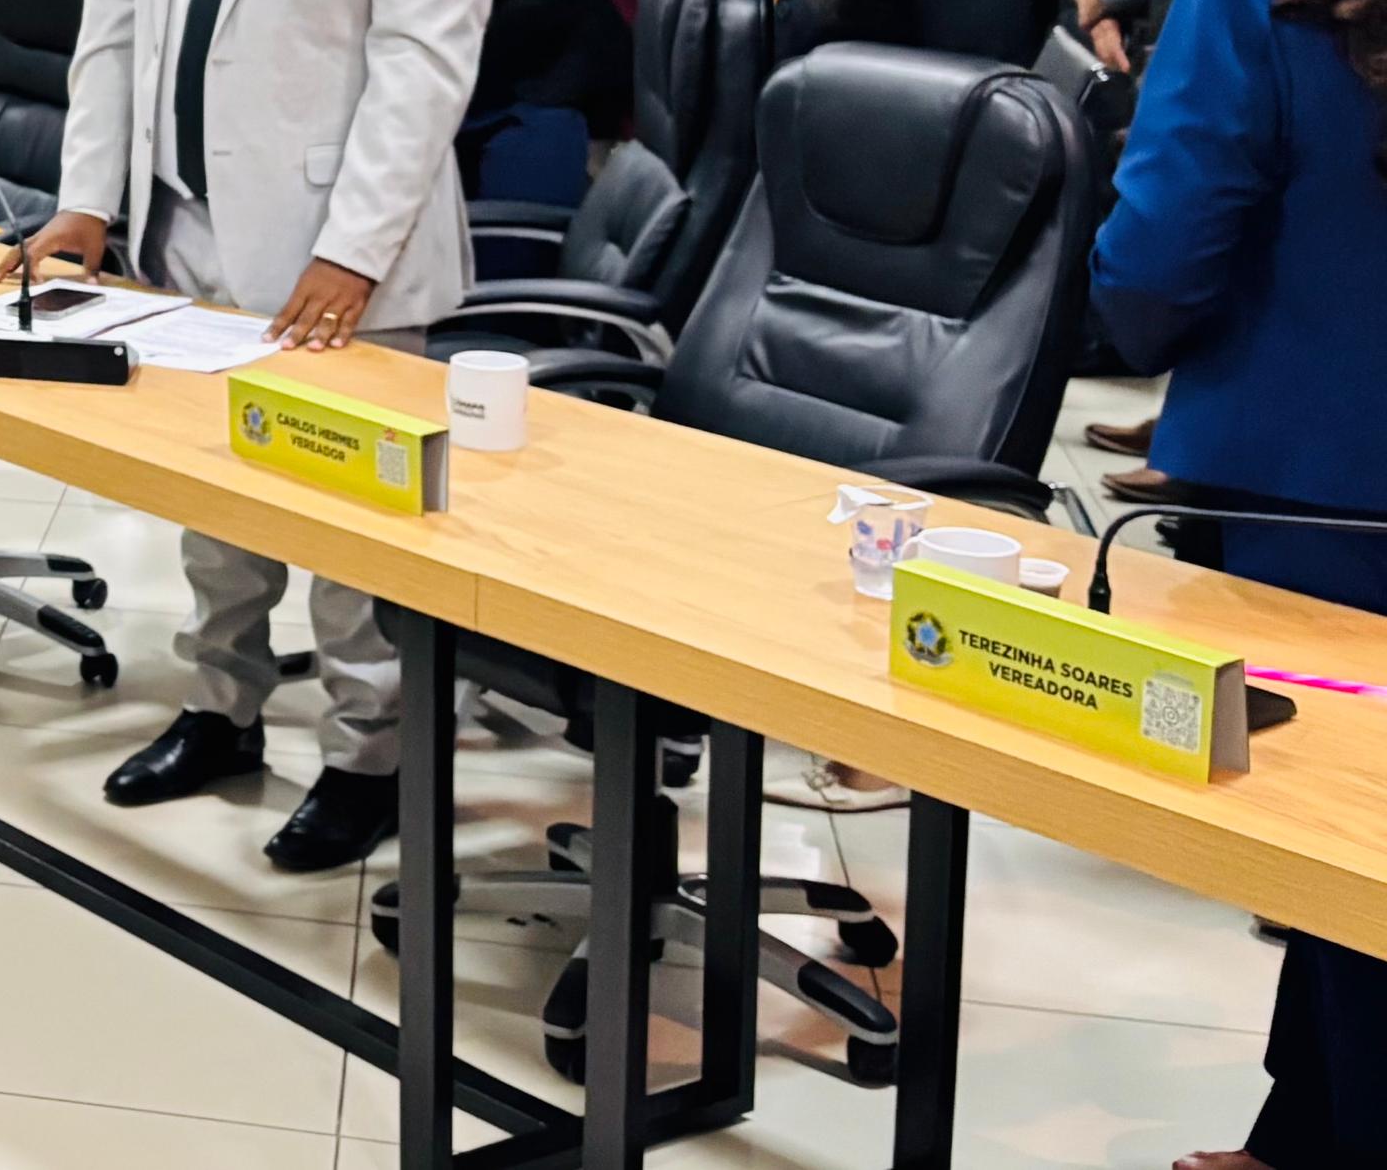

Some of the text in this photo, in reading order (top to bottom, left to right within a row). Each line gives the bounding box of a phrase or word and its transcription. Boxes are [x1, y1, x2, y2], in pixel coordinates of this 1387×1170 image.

[276, 412, 360, 451] CARLOS HERMES
[290, 433, 346, 462] VEREADOR
[958, 629, 1134, 699] TEREZINHA SOARES
[988, 661, 1099, 711] VEREADORA
